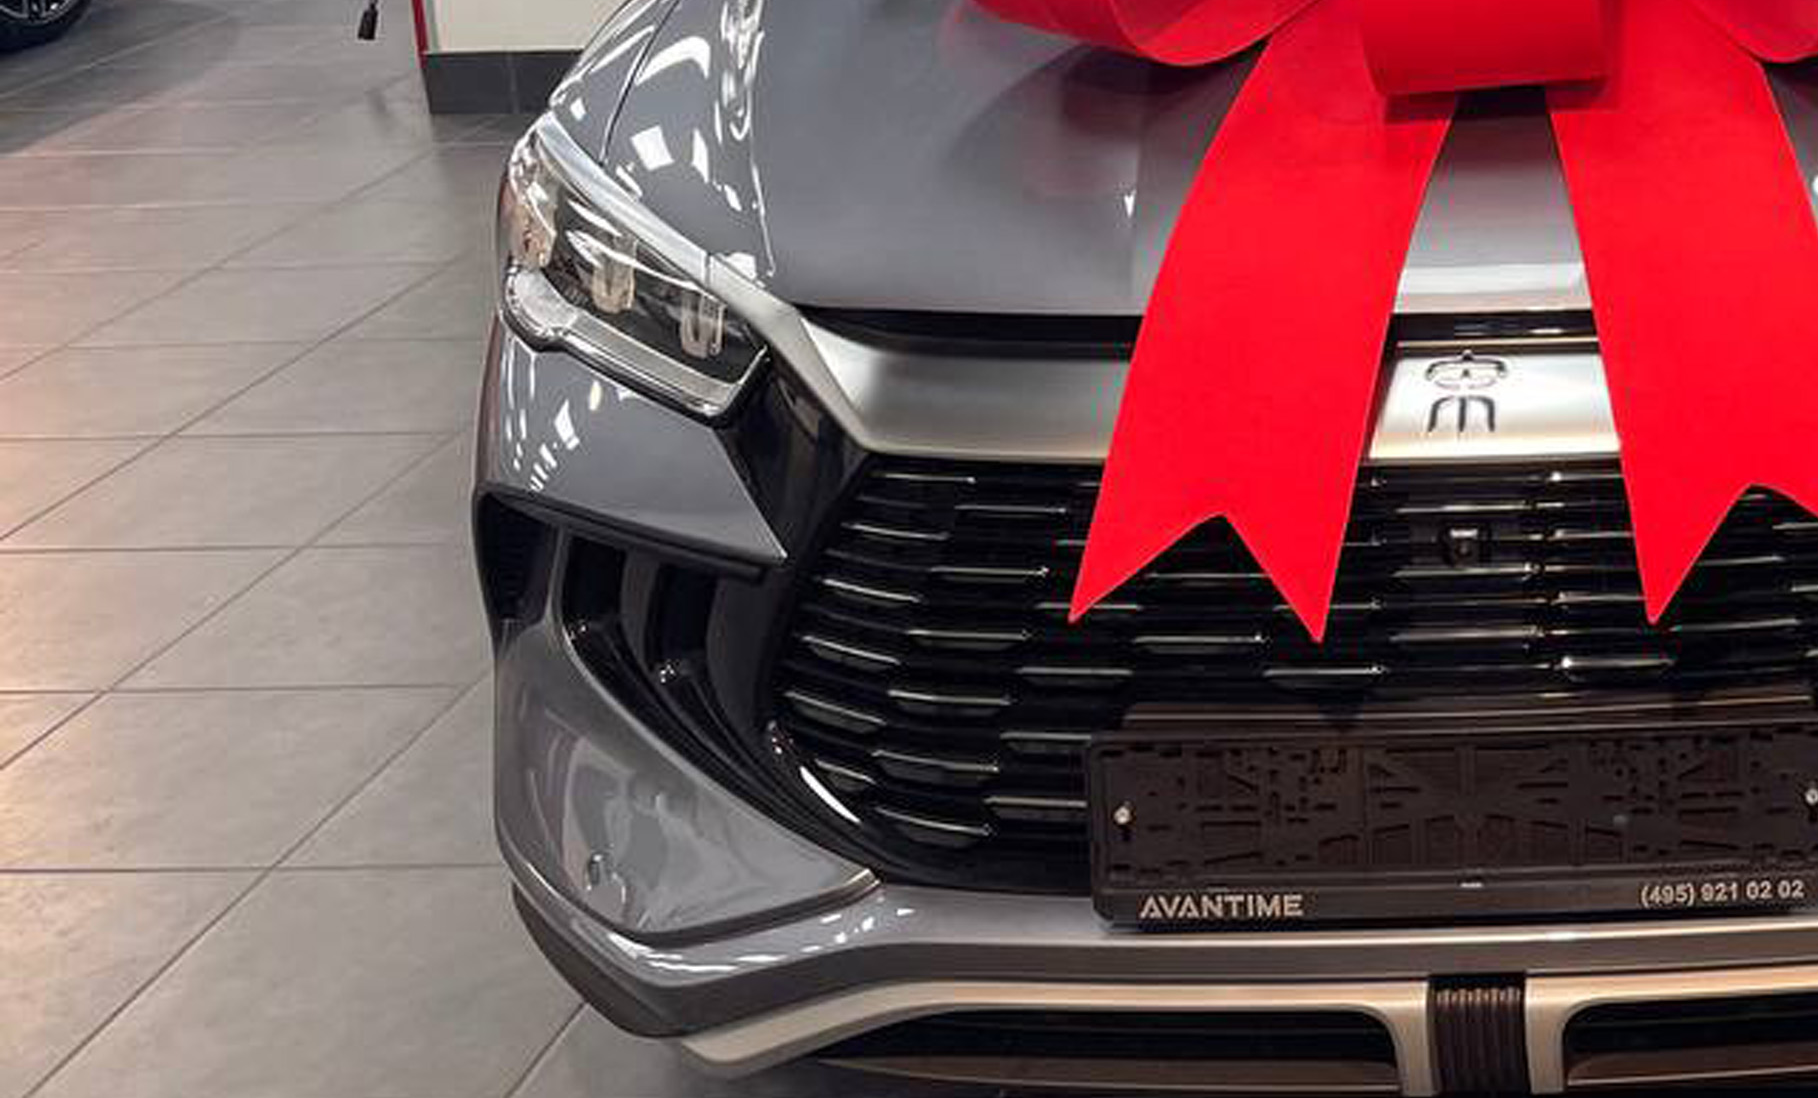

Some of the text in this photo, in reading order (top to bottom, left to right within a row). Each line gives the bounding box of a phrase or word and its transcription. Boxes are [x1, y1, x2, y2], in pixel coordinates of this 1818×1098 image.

[1140, 879, 1805, 919] AVANTIME (495) 921 02 02
